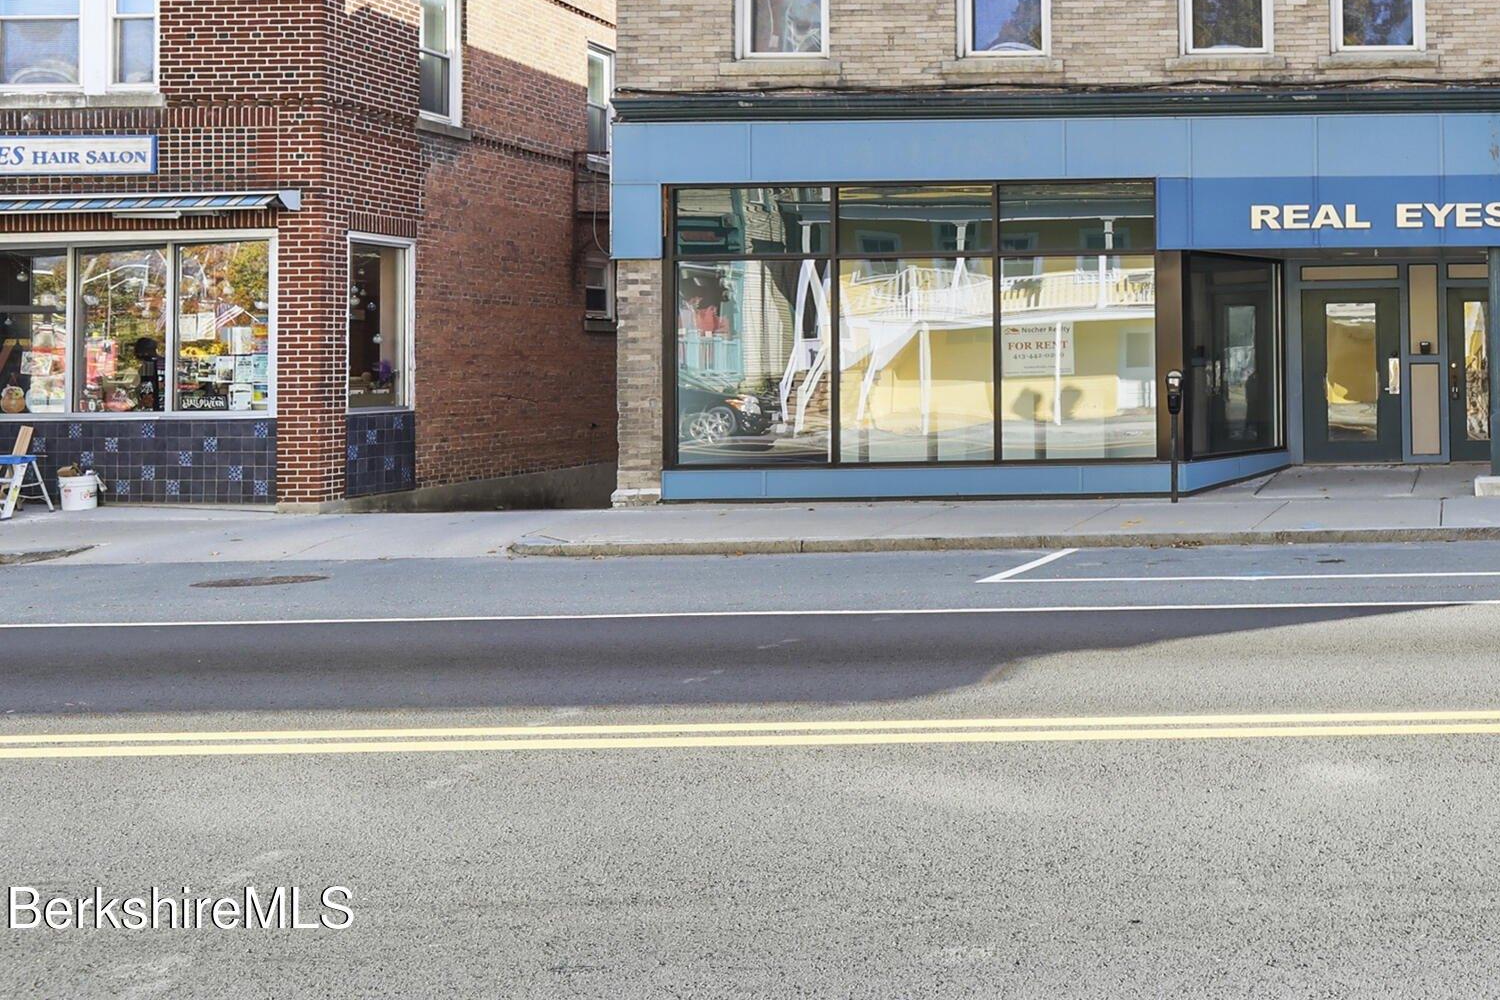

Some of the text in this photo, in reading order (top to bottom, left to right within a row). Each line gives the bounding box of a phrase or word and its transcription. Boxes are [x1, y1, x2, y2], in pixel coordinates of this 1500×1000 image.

[32, 150, 80, 164] HAIR
[86, 150, 147, 164] SALON
[1250, 203, 1371, 230] REAL
[1008, 341, 1032, 351] FOR
